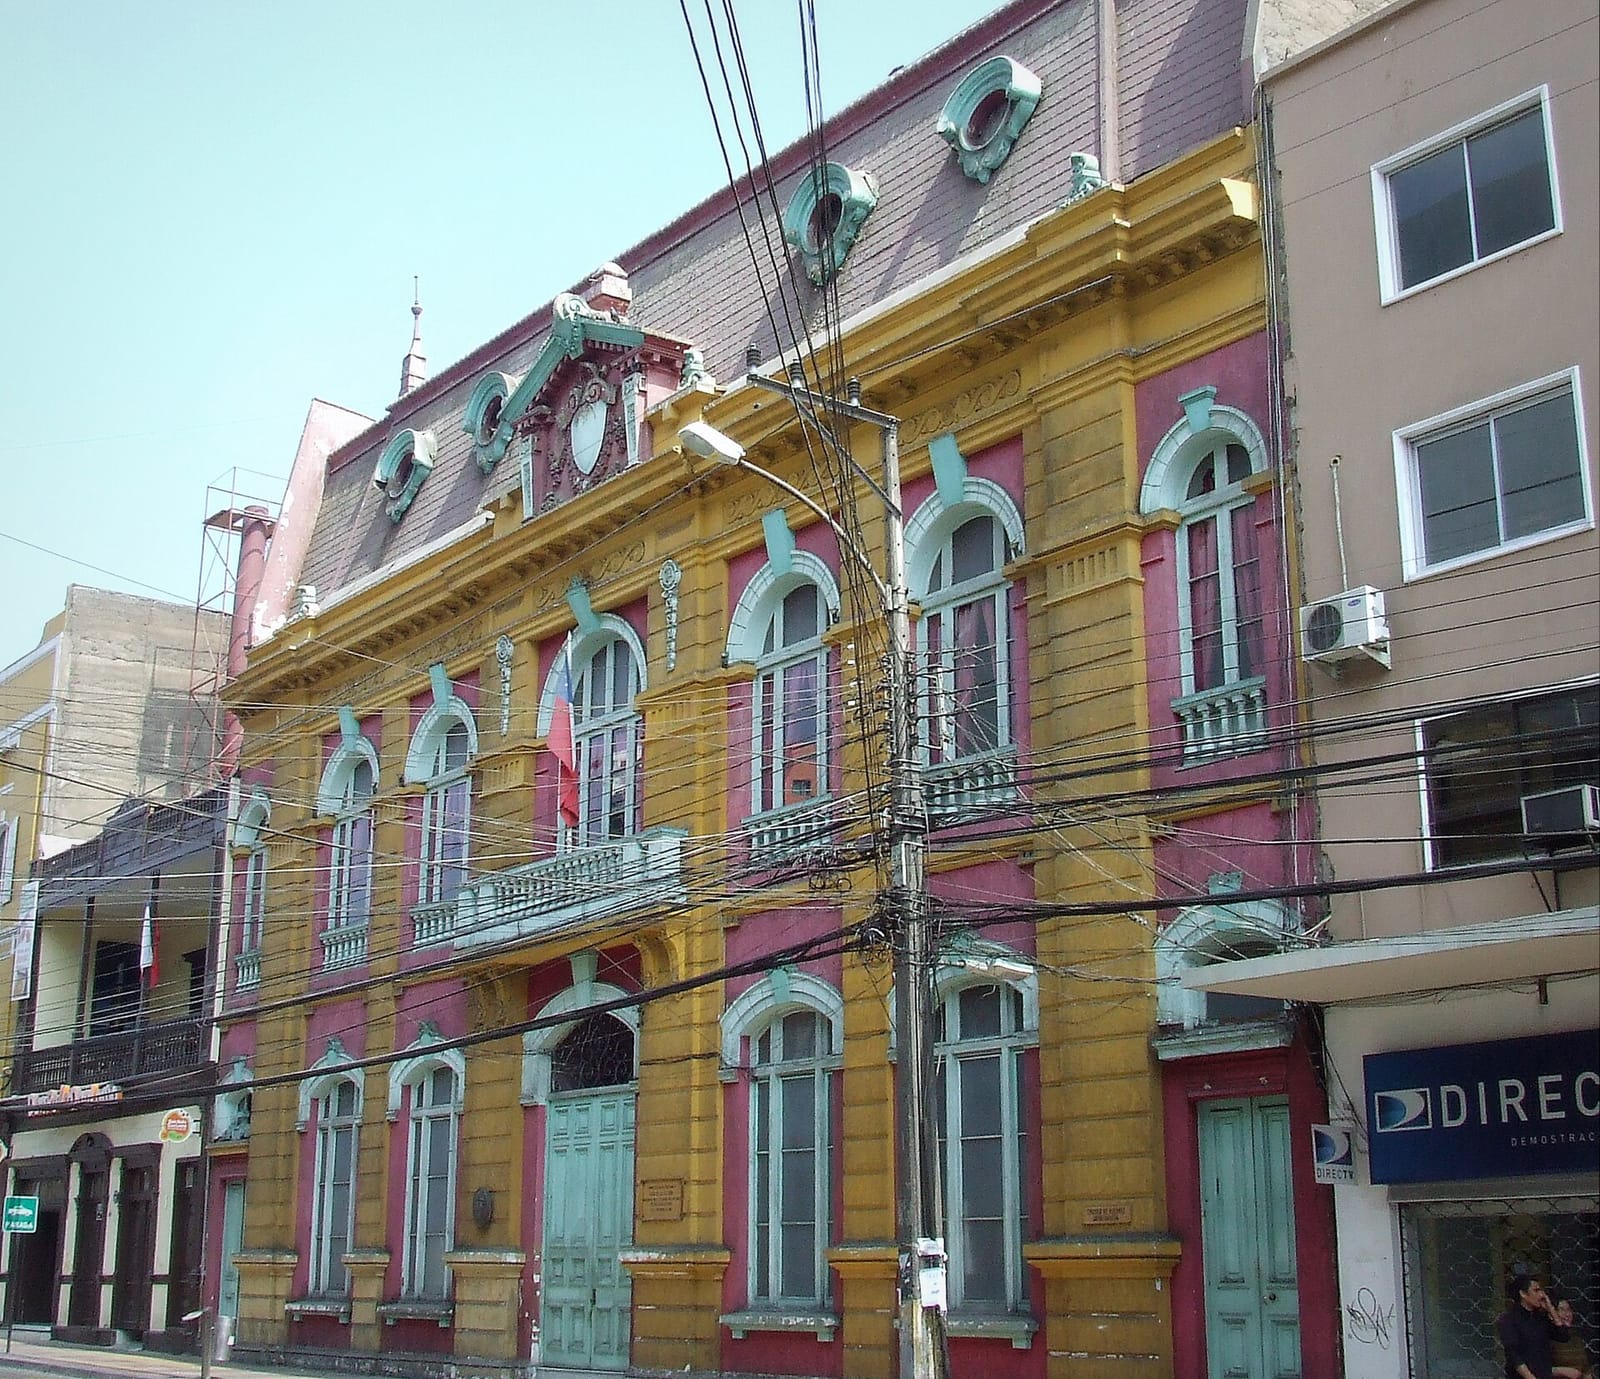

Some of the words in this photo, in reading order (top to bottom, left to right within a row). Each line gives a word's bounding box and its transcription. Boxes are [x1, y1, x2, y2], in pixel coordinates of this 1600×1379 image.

[1439, 1071, 1599, 1128] DIREC
[1511, 1131, 1596, 1147] DEMOSTRAC
[1317, 1168, 1354, 1179] DIRECTV
